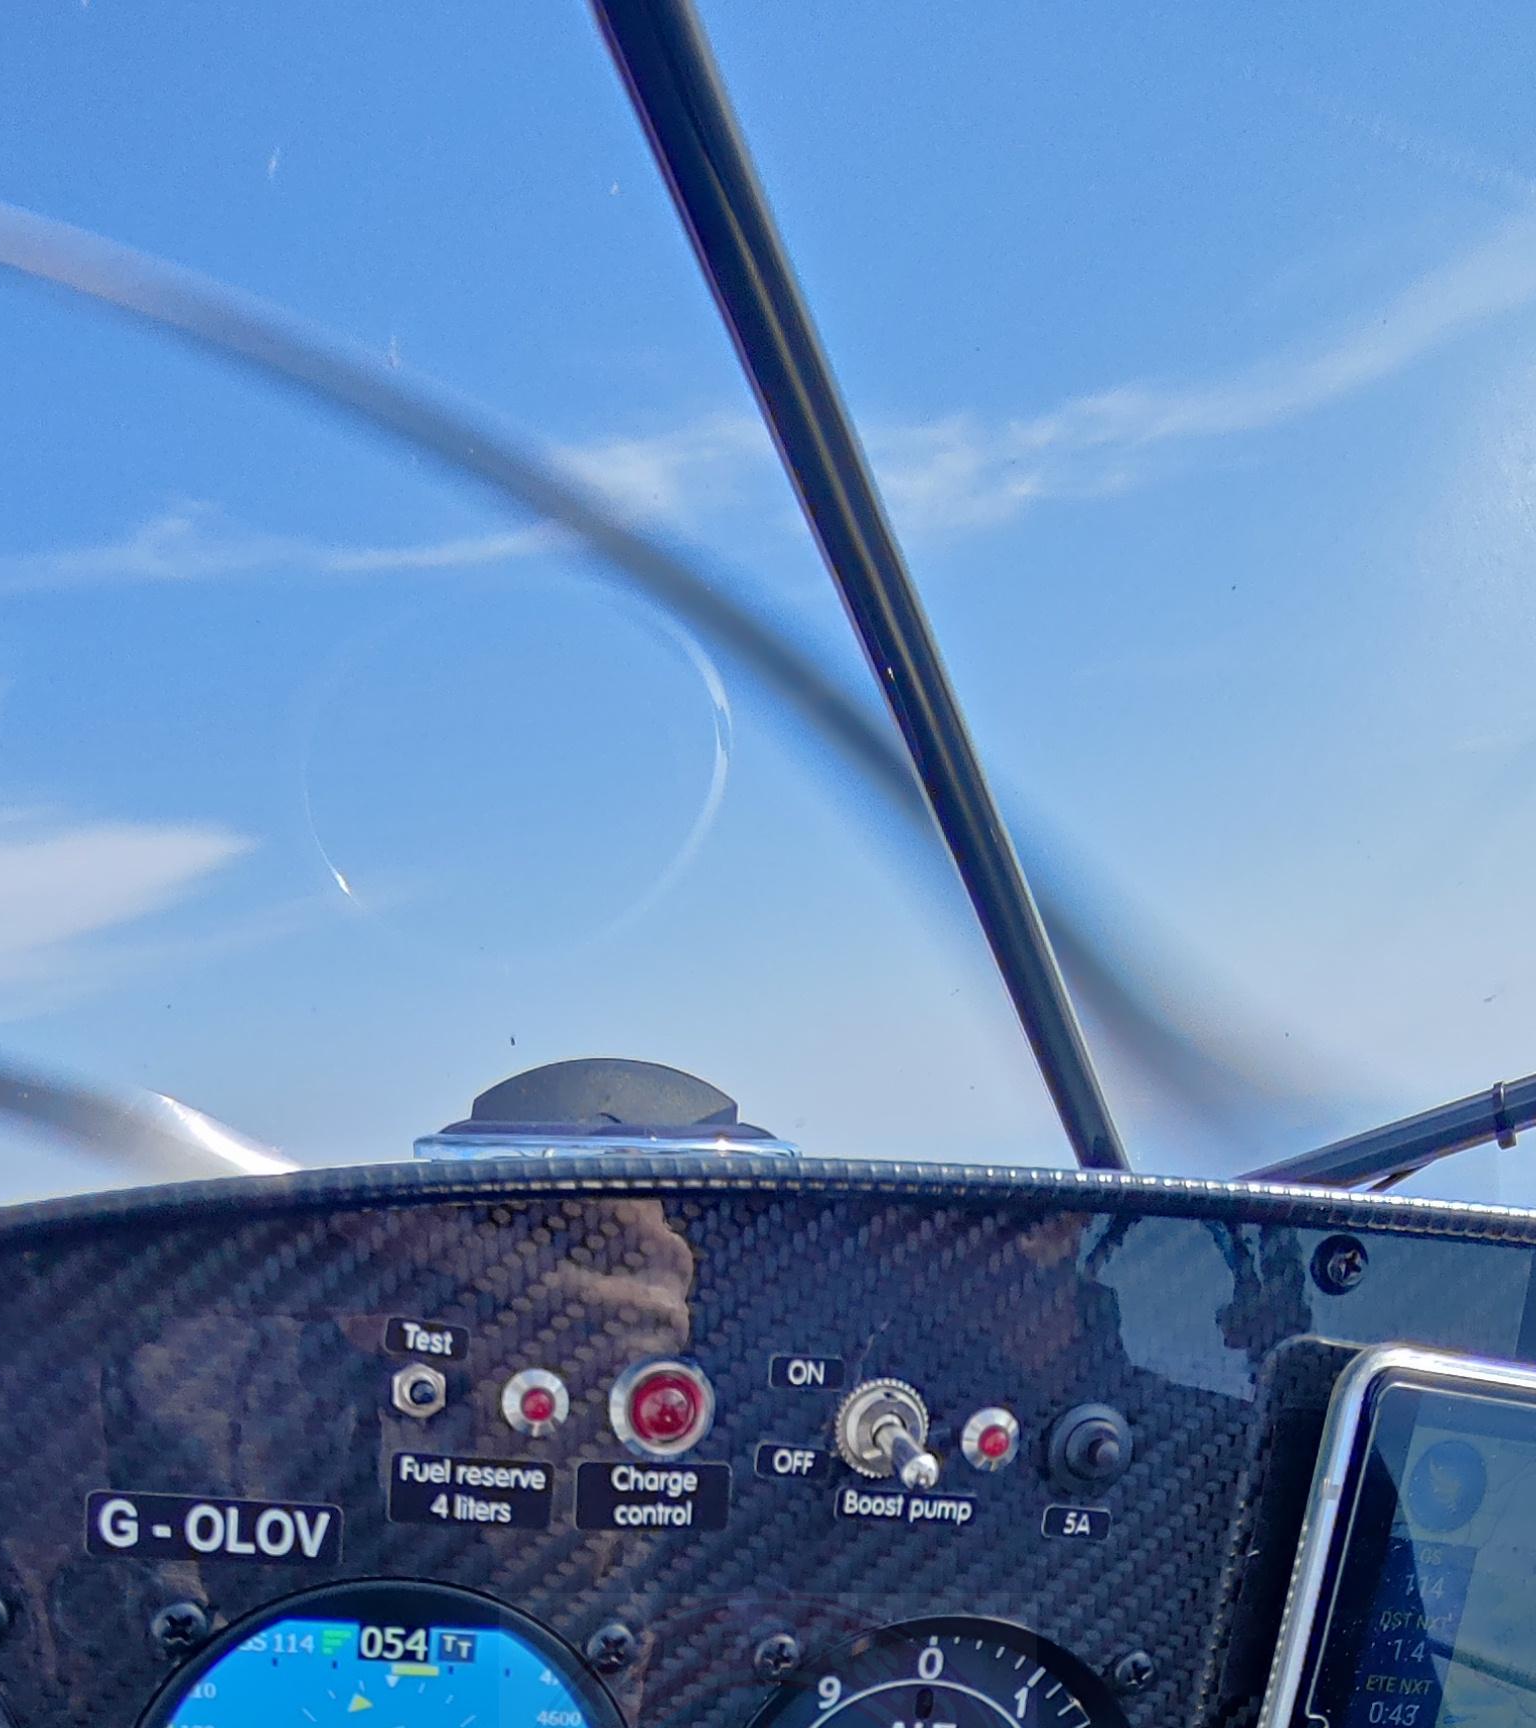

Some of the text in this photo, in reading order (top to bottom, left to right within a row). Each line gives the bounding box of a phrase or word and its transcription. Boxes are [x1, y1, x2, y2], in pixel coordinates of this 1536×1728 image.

[403, 1324, 453, 1355] Test
[788, 1360, 824, 1385] ON
[400, 1457, 546, 1491] Fuel reserve
[773, 1450, 814, 1474] OFF
[612, 1466, 698, 1495] Charge
[431, 1498, 511, 1523] 4 liters
[614, 1502, 693, 1525] control
[843, 1489, 972, 1525] Boost pump
[99, 1499, 331, 1557] G OLOV
[1063, 1512, 1090, 1535] 5A
[359, 1627, 427, 1659] 054
[1369, 1701, 1420, 1726] 0:43
